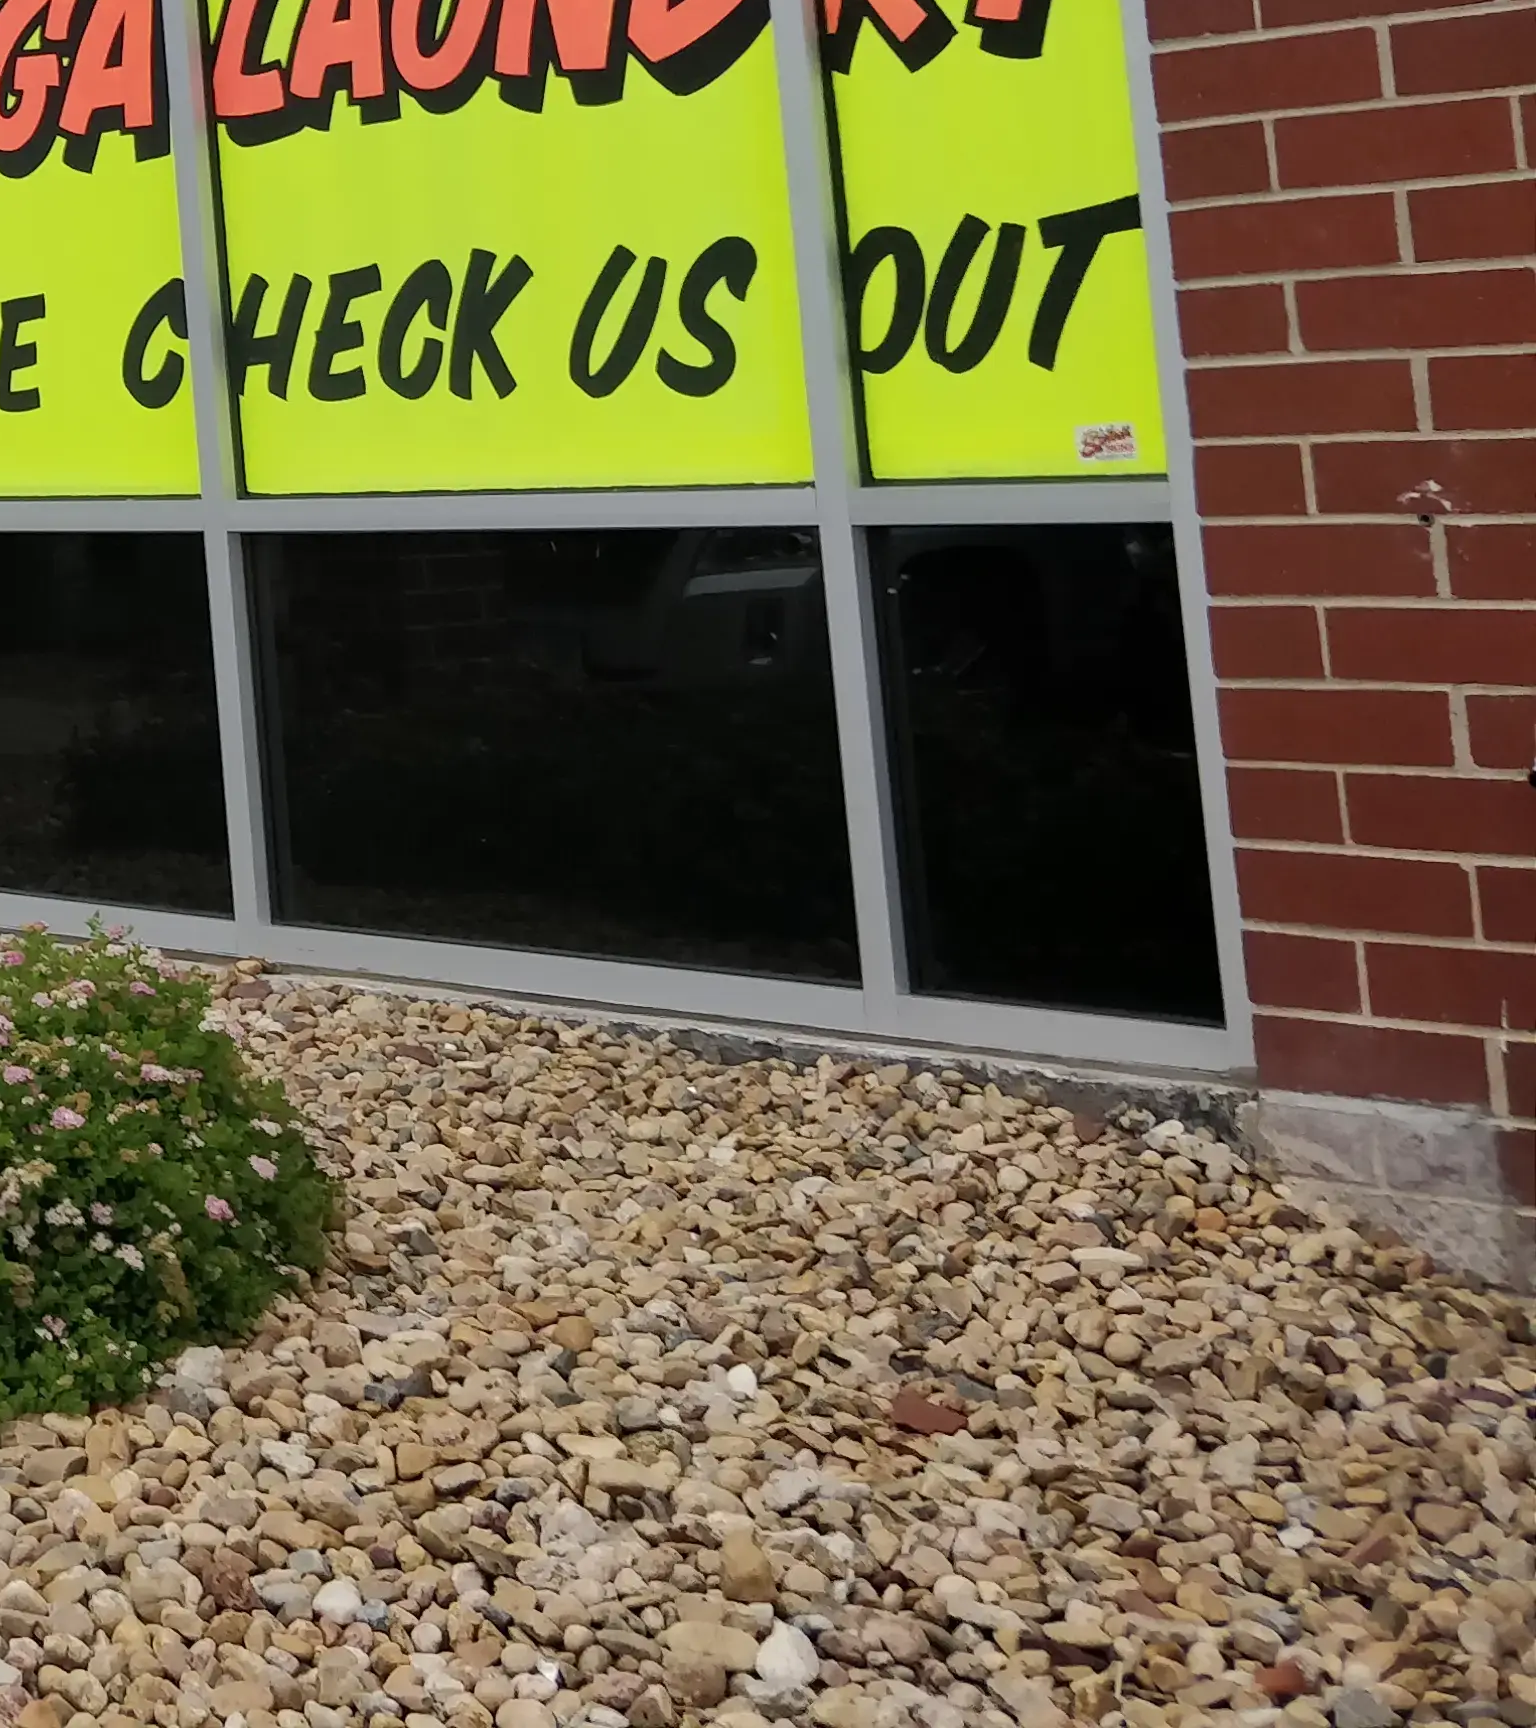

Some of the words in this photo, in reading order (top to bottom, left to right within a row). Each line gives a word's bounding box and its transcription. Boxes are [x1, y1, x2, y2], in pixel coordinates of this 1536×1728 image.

[122, 245, 535, 412] CHECK
[566, 235, 758, 399] US
[848, 191, 1144, 377] OUT
